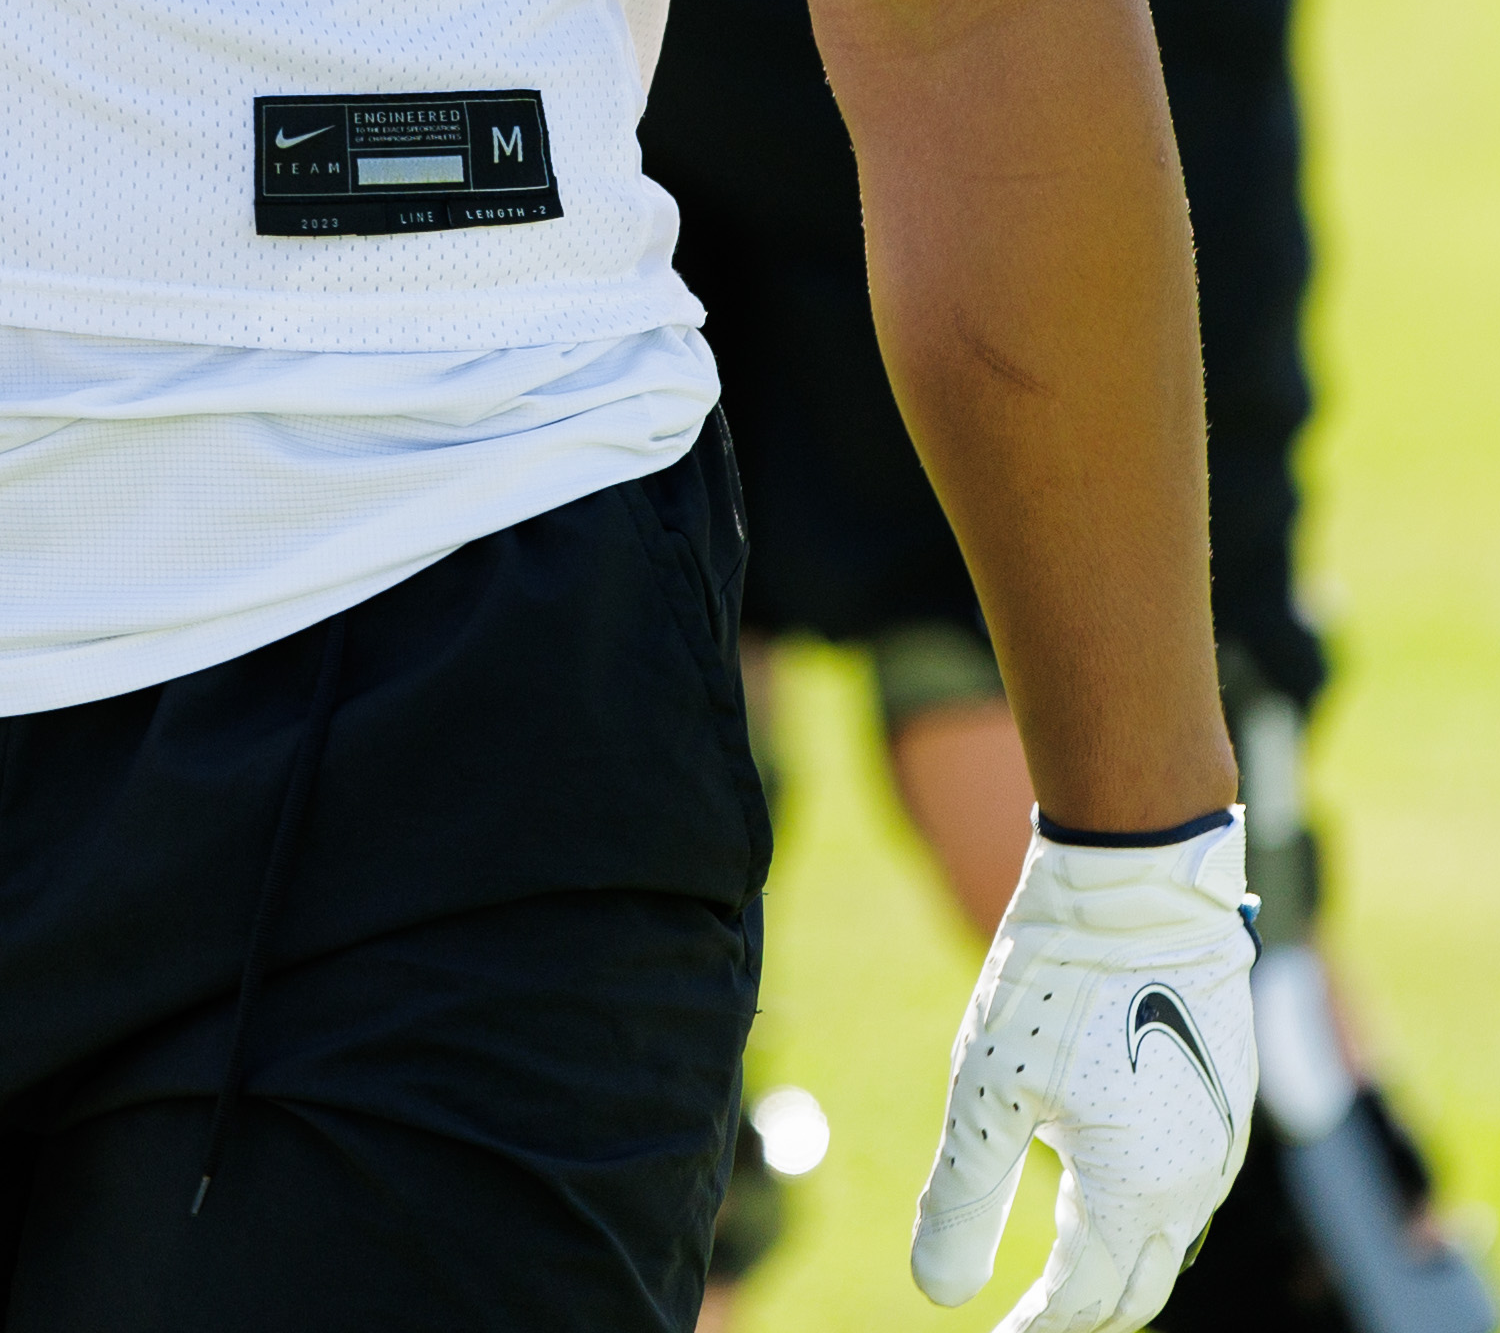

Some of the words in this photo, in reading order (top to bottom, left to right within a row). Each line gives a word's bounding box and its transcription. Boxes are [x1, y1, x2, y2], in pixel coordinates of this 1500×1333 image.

[354, 109, 461, 125] ENGINEERED
[491, 125, 523, 164] M
[273, 161, 340, 175] TEAM
[400, 211, 435, 224] LINE
[465, 207, 526, 220] LENGTH
[301, 218, 340, 230] 2023
